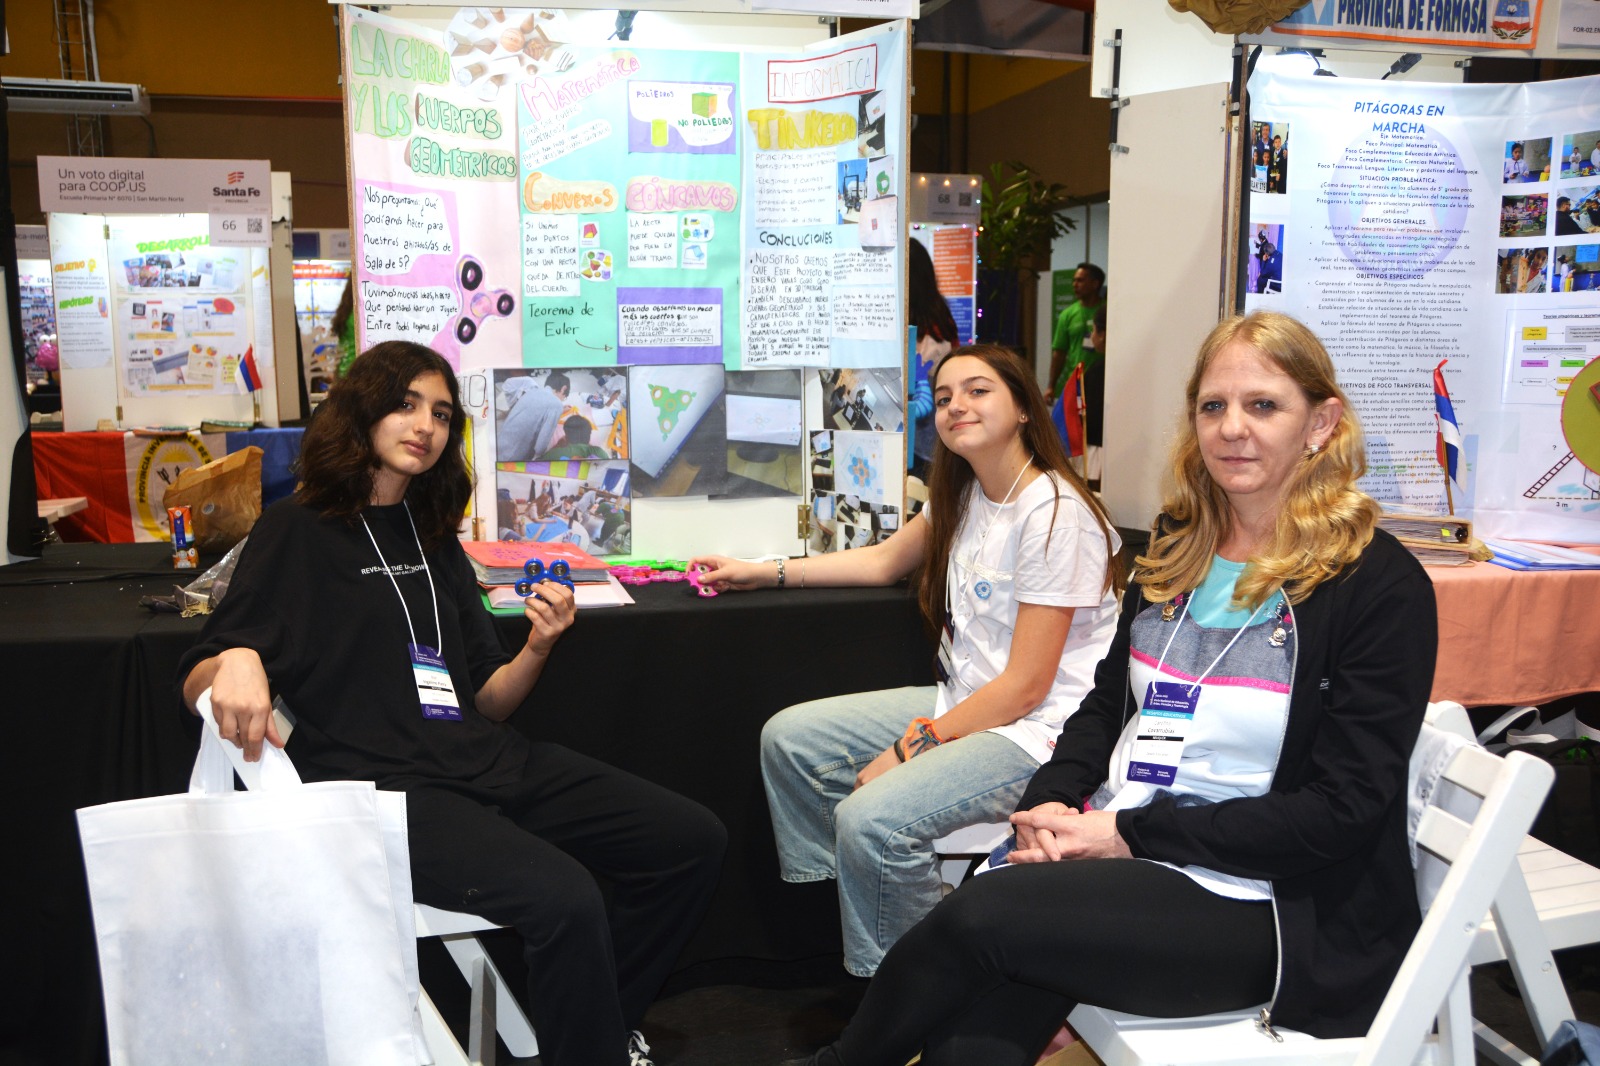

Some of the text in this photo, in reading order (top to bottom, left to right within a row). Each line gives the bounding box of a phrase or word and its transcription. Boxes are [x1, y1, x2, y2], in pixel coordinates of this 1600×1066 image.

[1338, 0, 1486, 33] PROVINCIA DE FORMOSA
[352, 25, 450, 83] LA CHARLA
[351, 83, 367, 131] Y
[373, 86, 412, 137] LOS
[416, 93, 502, 139] CUERPOS
[1354, 101, 1445, 116] PITÁGORAS EN
[1372, 122, 1425, 133] MARCHA
[58, 169, 144, 183] Un voto digital
[59, 181, 146, 193] para COOP.US
[213, 187, 260, 197] Santa Fe
[364, 186, 380, 203] Nos
[222, 220, 236, 231] 66
[407, 214, 424, 228] hacer
[427, 222, 443, 234] para
[630, 219, 640, 227] LA
[136, 235, 210, 253] DESARROLL
[364, 234, 399, 246] nuestros
[443, 244, 451, 252] de
[759, 231, 833, 246] CONCLUCIONES
[365, 255, 410, 270] Sala de 5?
[753, 265, 767, 275] QUE
[775, 267, 790, 275] ESTE
[362, 281, 396, 298] Tuvimos
[526, 284, 540, 293] DEL
[365, 300, 380, 311] Que
[426, 304, 435, 312] un
[528, 302, 594, 318] Teorema de
[622, 305, 649, 313] Cuando
[366, 315, 391, 330] Entre
[545, 322, 579, 337] Euler
[139, 456, 151, 503] PROVINCIA
